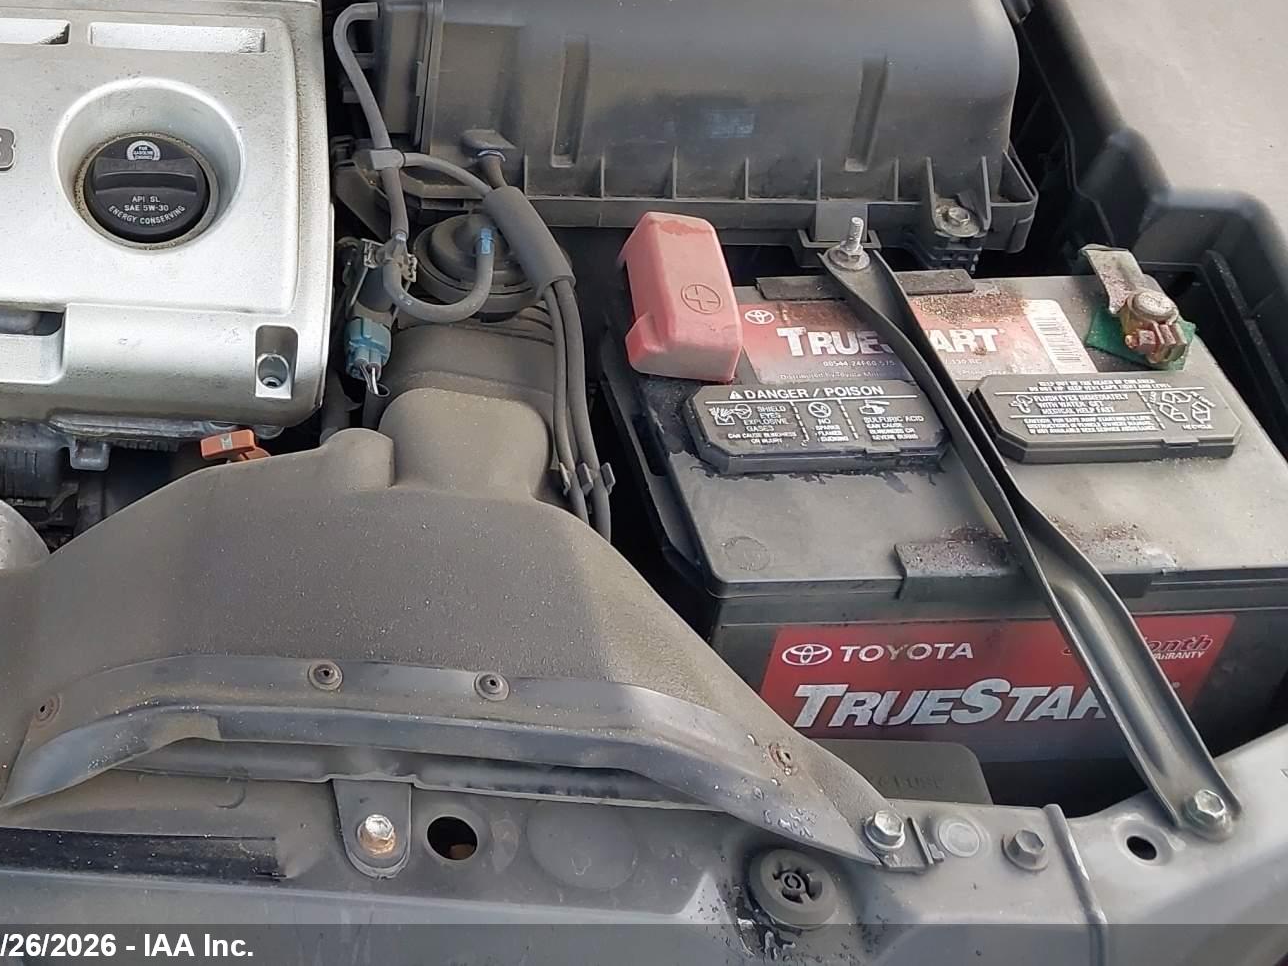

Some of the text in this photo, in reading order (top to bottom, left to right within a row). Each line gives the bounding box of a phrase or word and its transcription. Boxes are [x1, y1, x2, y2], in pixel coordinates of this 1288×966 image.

[108, 205, 186, 225] ENERGY CONSERVING
[124, 204, 169, 212] SAE 5W-30
[744, 388, 809, 399] DANGER
[823, 386, 884, 397] POISON
[840, 643, 973, 662] TOYOTA
